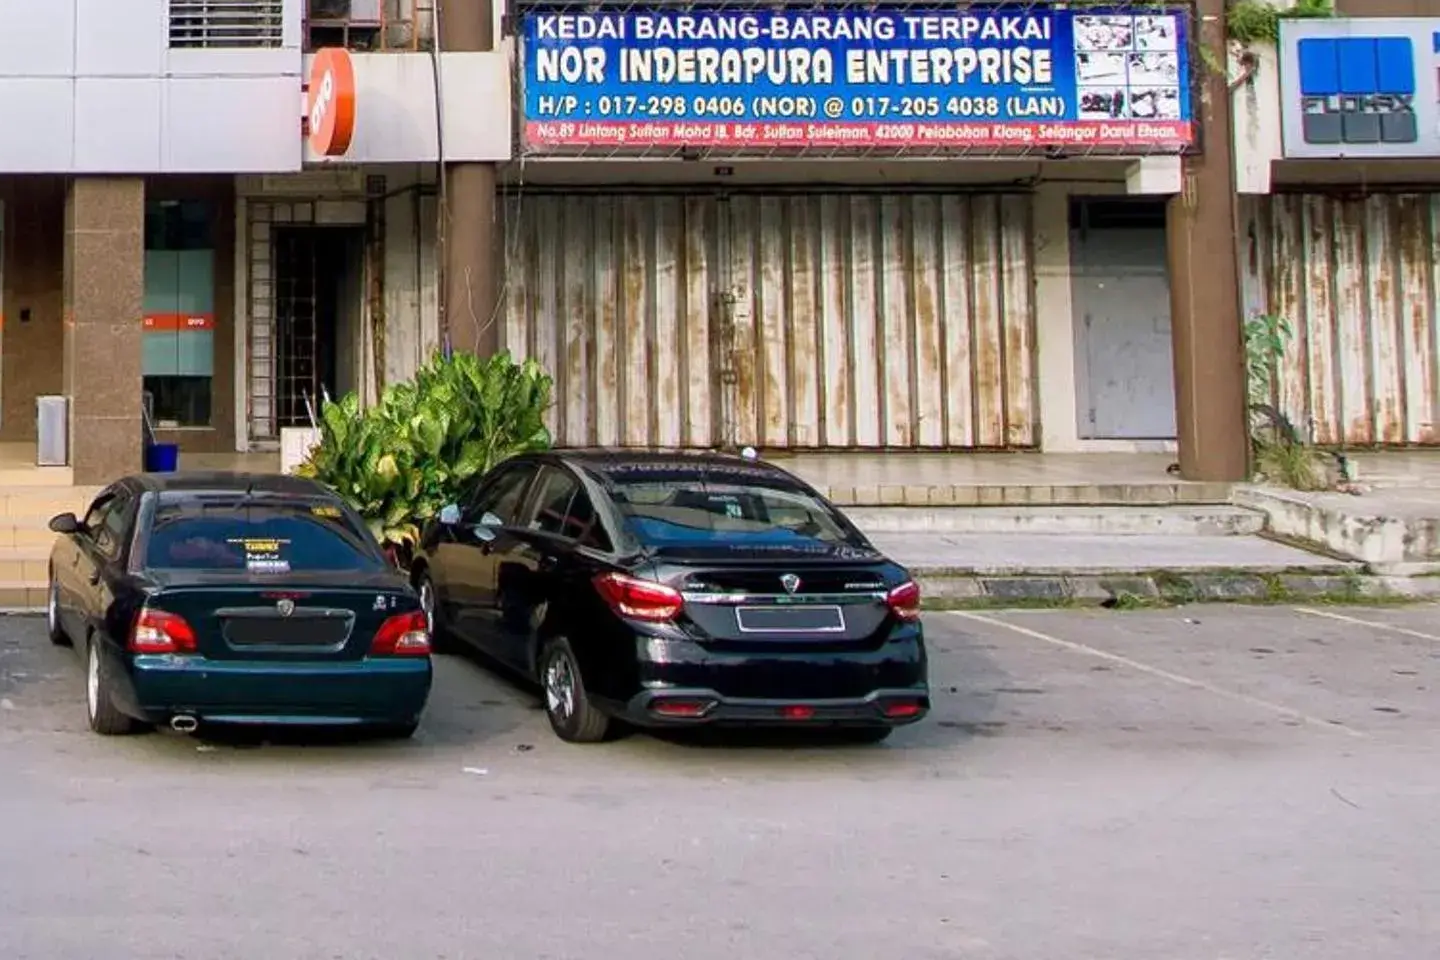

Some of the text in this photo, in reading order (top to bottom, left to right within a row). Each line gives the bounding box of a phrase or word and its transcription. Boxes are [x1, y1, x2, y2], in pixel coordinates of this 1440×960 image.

[537, 16, 1051, 40] KEDAI BARANG-BARANG TERPAKAI
[536, 46, 1052, 85] NOR INDERAPURA ENTERPRISE
[539, 96, 578, 116] H/P
[598, 96, 686, 116] 017-298
[693, 96, 746, 116] 0406
[752, 96, 817, 117] (NOR)
[824, 97, 844, 117] @
[851, 97, 939, 116] 017-205
[946, 97, 999, 116] 4038
[1006, 96, 1066, 117] (LAN)
[578, 123, 625, 139] Lintang
[673, 123, 710, 138] Mohd
[875, 123, 914, 138] 42000
[1038, 124, 1097, 140] Selangor
[1100, 125, 1134, 138] Darul
